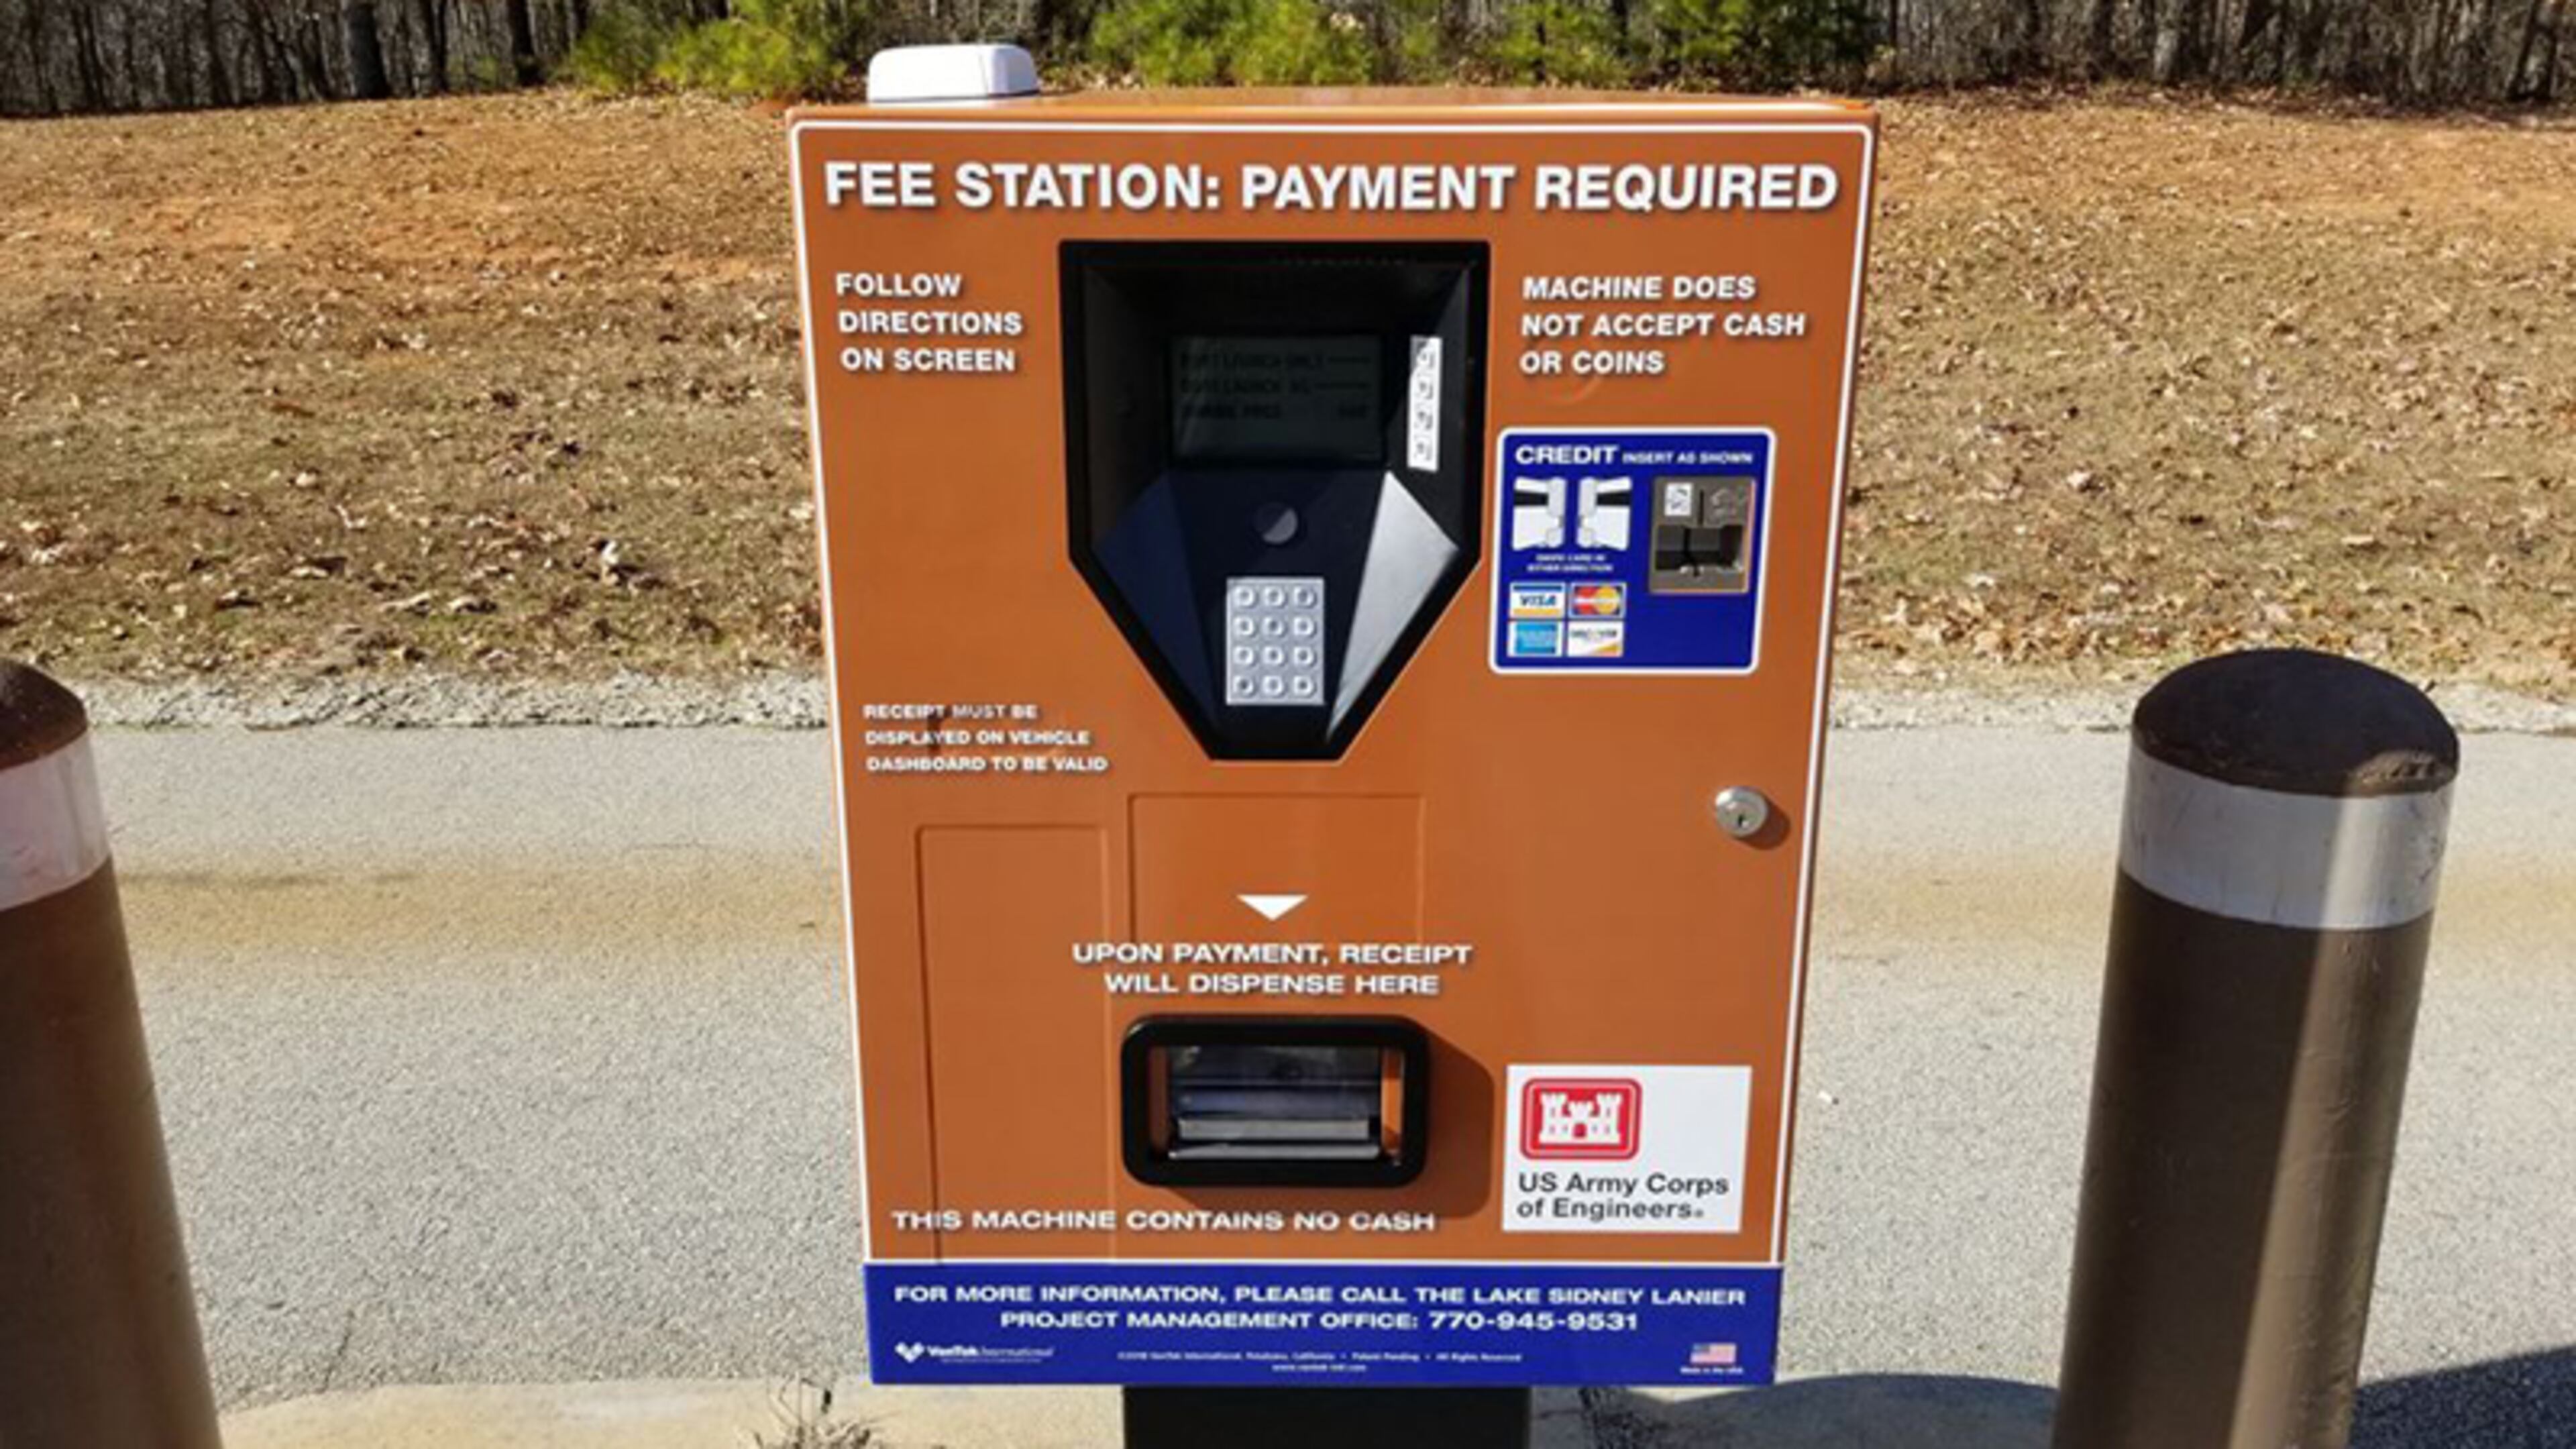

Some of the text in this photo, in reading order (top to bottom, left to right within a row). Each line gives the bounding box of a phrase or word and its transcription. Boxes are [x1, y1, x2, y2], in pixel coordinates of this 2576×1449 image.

[825, 161, 1837, 211] FEE STATION: PAYMENT REQUIRED
[835, 272, 961, 297] FOLLOW
[1523, 275, 1756, 299] MACHINE DOES
[838, 310, 1022, 335] DIRECTIONS
[1521, 312, 1805, 337] NOT ACCEPT CASH
[841, 347, 1015, 372] ON SCREEN
[1519, 350, 1664, 374] OR COINS
[1515, 445, 1753, 465] CREDIT INSERT AS SHOWN
[863, 704, 1037, 719] RECEIPT MUST BE
[865, 729, 1089, 745] DISPLAYED ON VEHICLE
[866, 755, 1108, 771] DASHBOARD TO BE VALID
[1073, 943, 1472, 966] UPON PAYMENT, RECEIPT
[1104, 973, 1438, 994] WILL DISPENSE HERE
[1518, 1171, 1729, 1198] US Army Corps
[1516, 1197, 1544, 1218] of
[892, 1210, 1435, 1232] THIS MACHINE CONTAINS NO CASH
[894, 1285, 1746, 1305] FOR MORE INFORMATION, PLEASE CALL THE LAKE SIDNEY LANIER
[1000, 1311, 1637, 1331] PROJECT MANAGEMENT OFFICE: 770-945-9531
